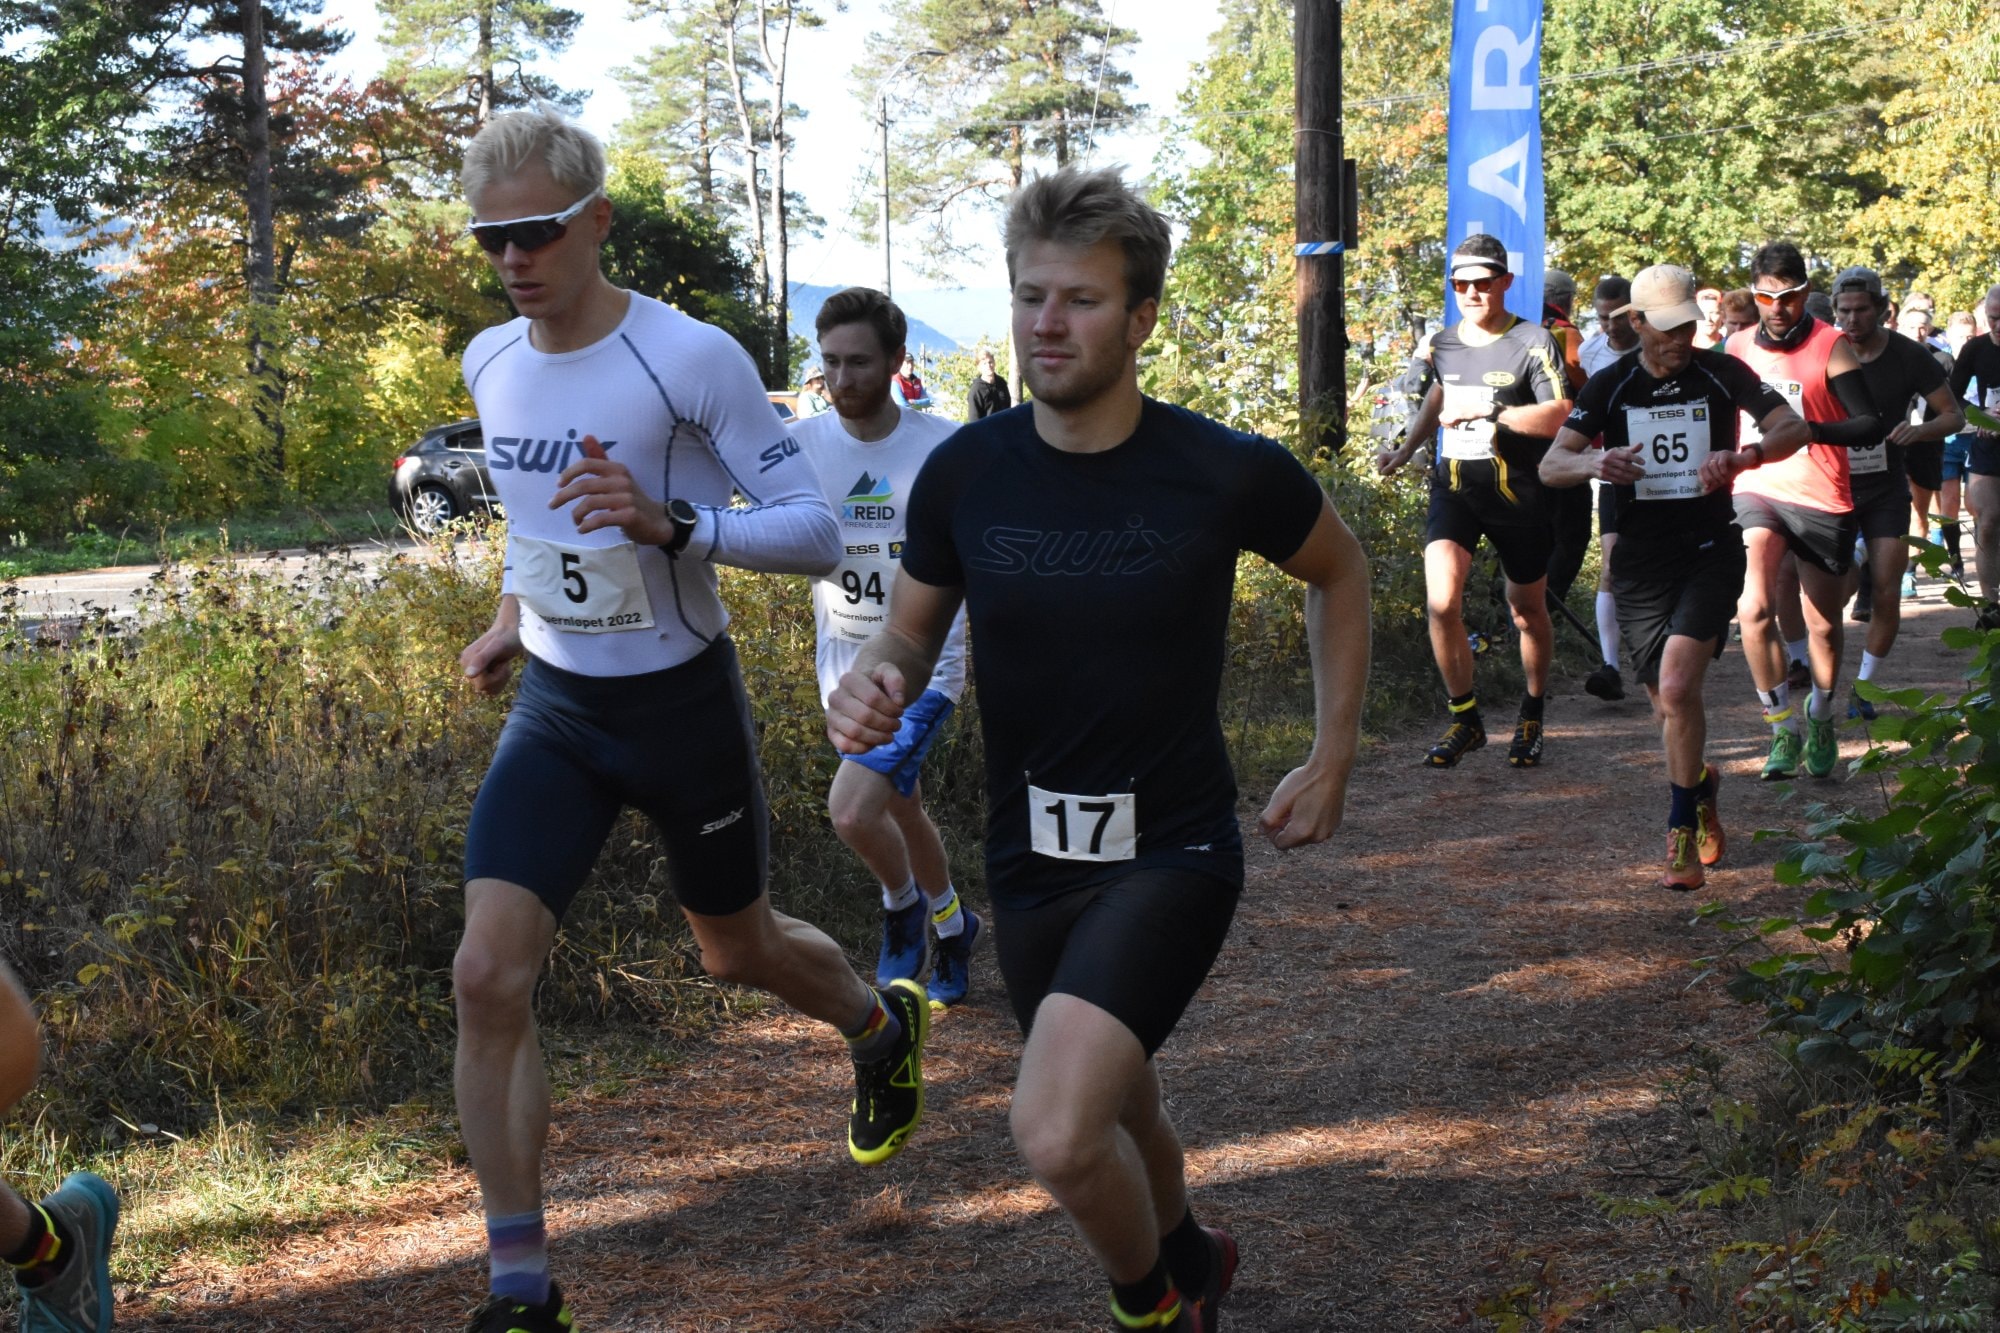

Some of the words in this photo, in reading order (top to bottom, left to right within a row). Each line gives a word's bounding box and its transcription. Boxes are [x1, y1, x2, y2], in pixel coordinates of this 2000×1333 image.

[1648, 409, 1685, 419] TESS
[1652, 432, 1689, 464] 65
[841, 505, 895, 520] XREID
[844, 521, 874, 529] FRENDE
[845, 544, 880, 555] ESS
[560, 552, 588, 604] 5
[841, 570, 885, 605] 94
[607, 612, 642, 627] 2022
[1045, 799, 1115, 855] 17
